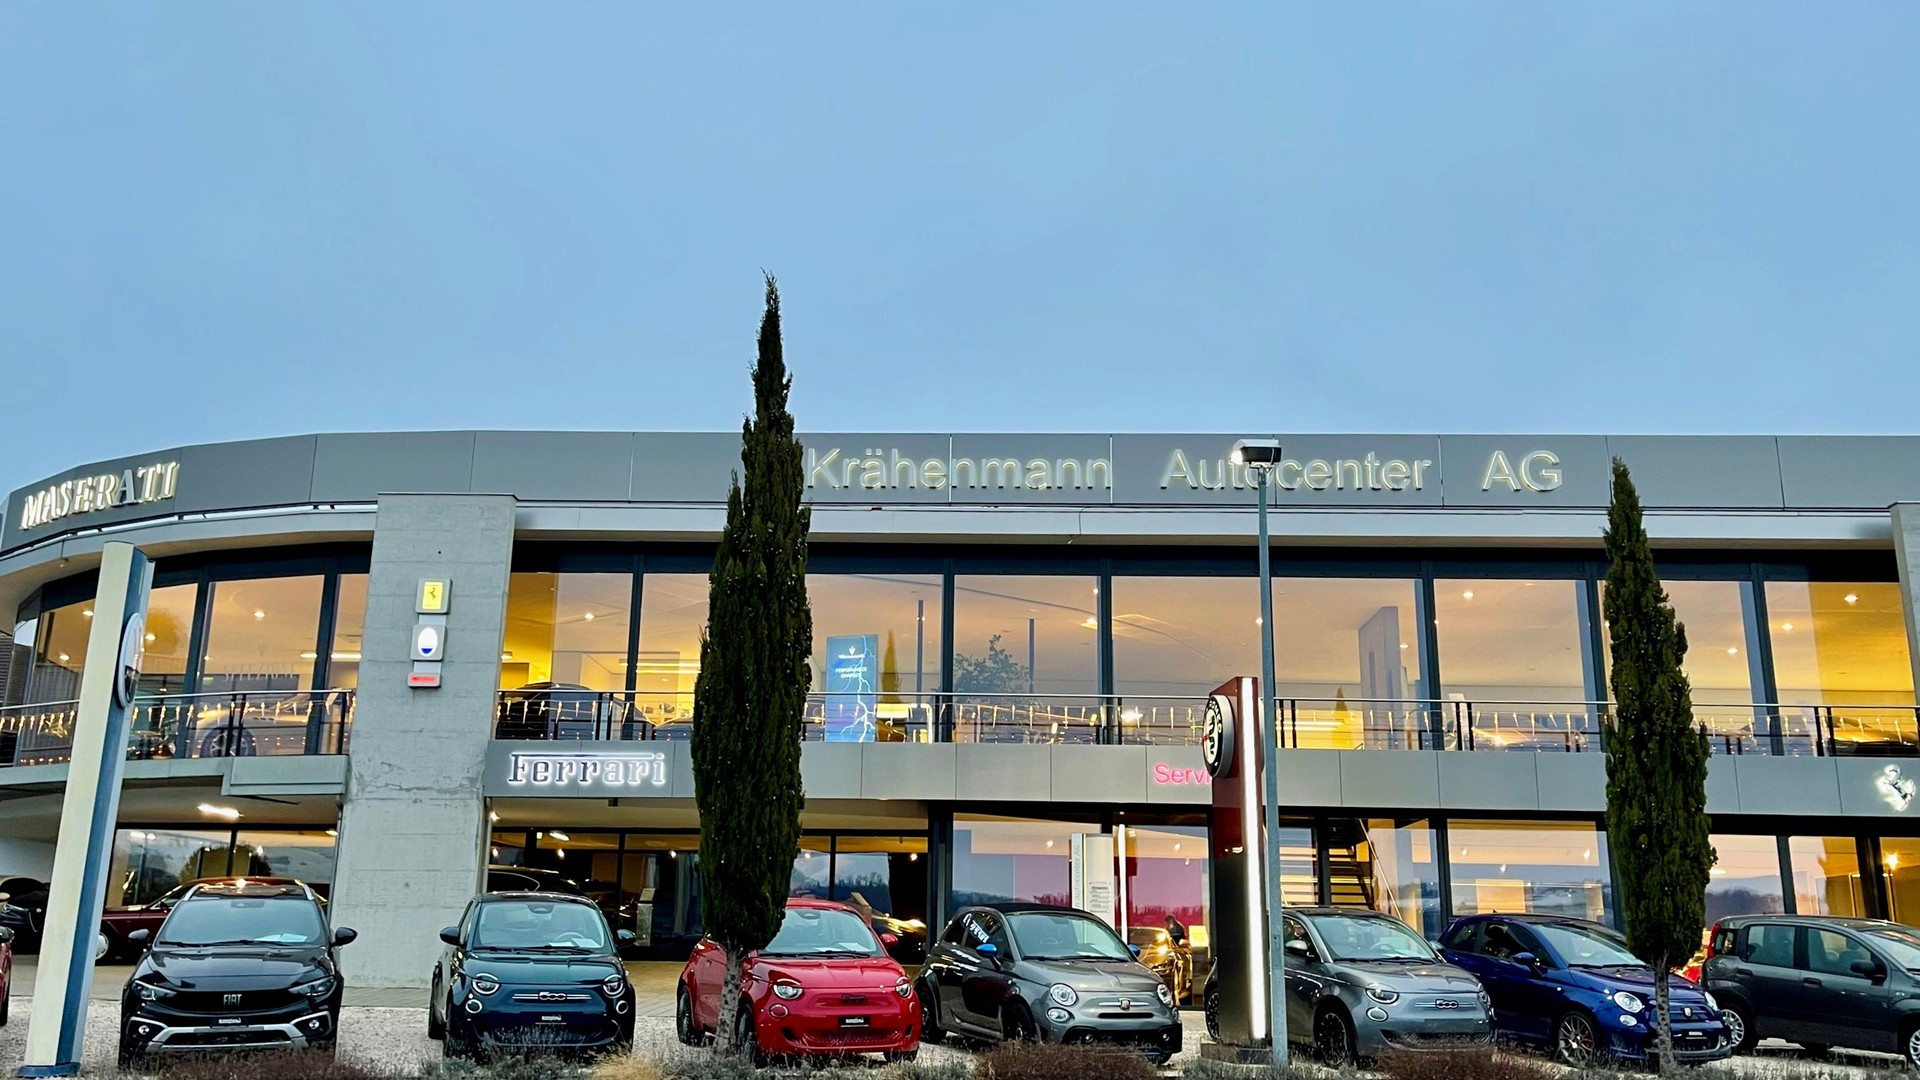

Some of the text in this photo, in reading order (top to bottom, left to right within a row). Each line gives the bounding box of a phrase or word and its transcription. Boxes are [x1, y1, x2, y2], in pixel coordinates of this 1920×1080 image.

[806, 448, 1563, 492] Krähenmann Autocenter AG
[19, 461, 179, 530] MASERATI
[507, 752, 667, 784] Ferrari
[1153, 762, 1212, 785] Servi
[223, 993, 242, 1007] FIAT
